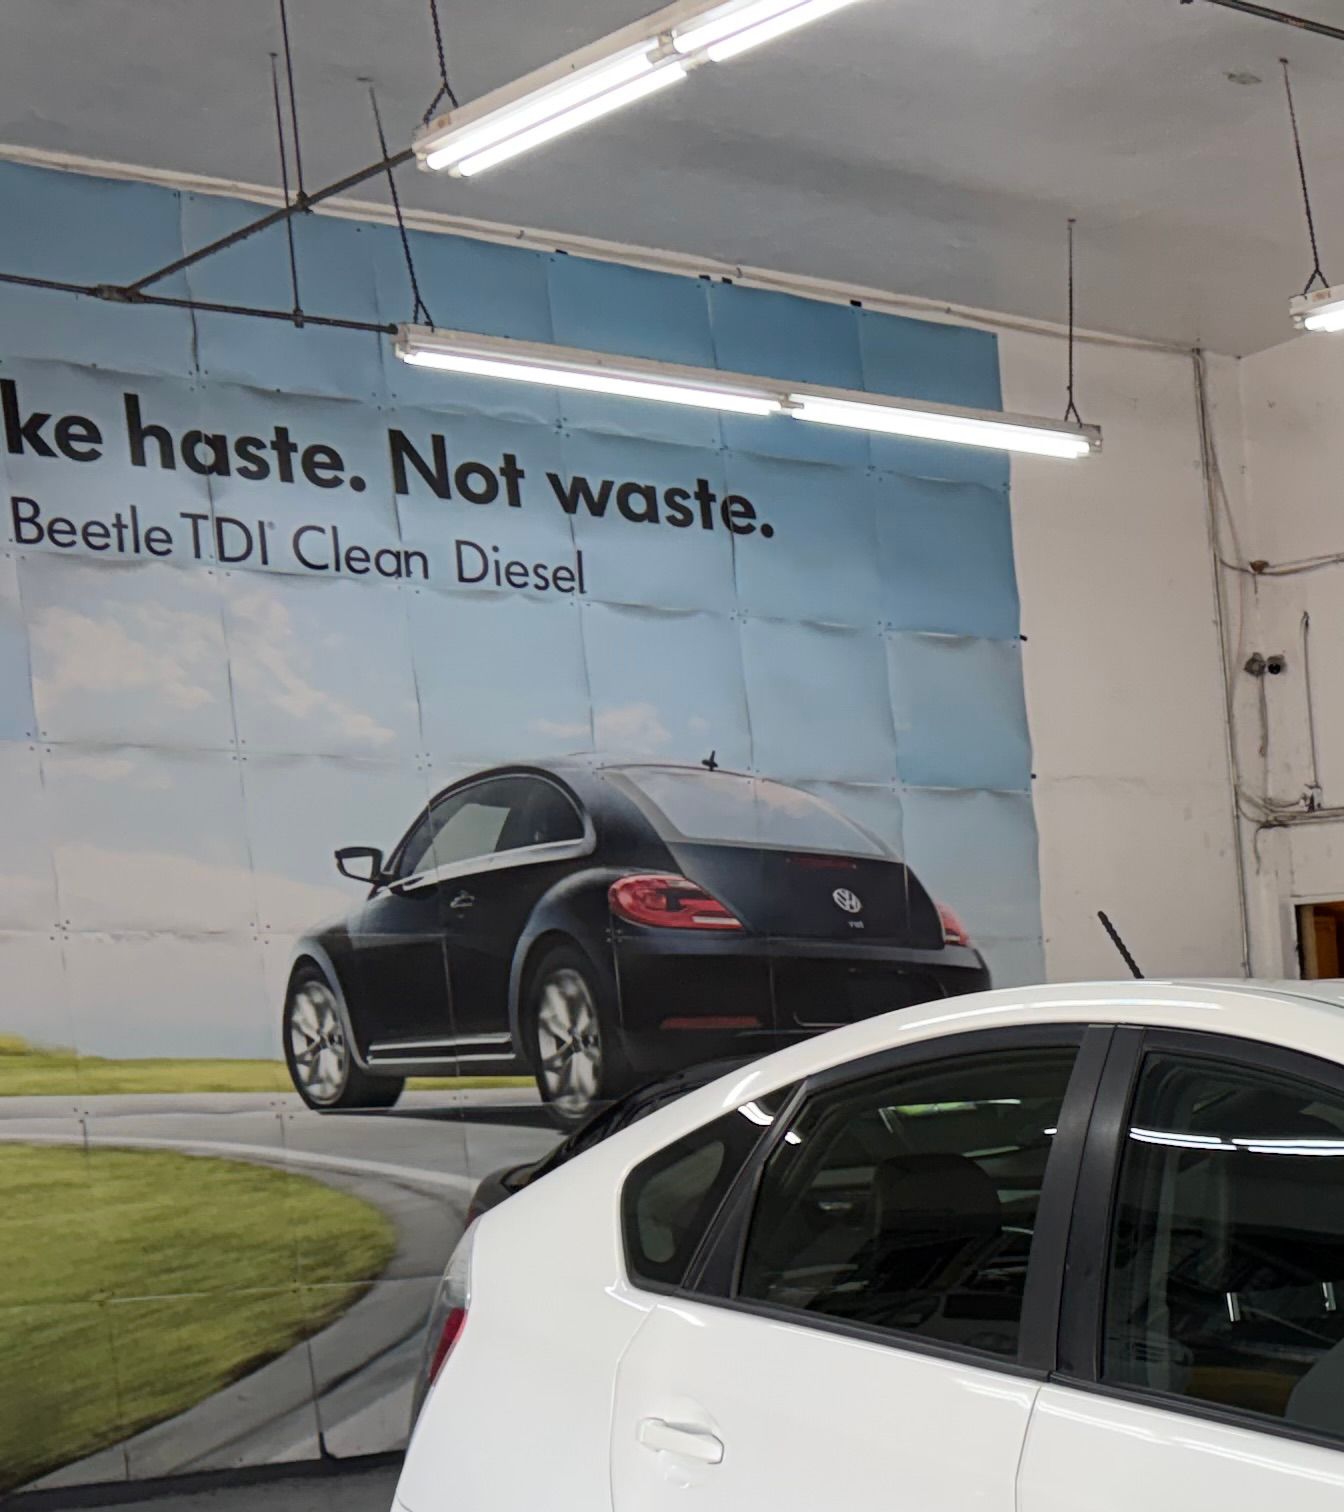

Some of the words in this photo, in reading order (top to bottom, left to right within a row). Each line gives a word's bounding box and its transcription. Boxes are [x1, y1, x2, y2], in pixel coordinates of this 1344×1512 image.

[0, 378, 103, 462] ke
[123, 392, 367, 493] haste.
[388, 428, 525, 508] Not
[545, 472, 775, 538] waste.
[11, 496, 173, 556] Beetle
[292, 524, 429, 580] Clean
[455, 539, 587, 595] Diesel
